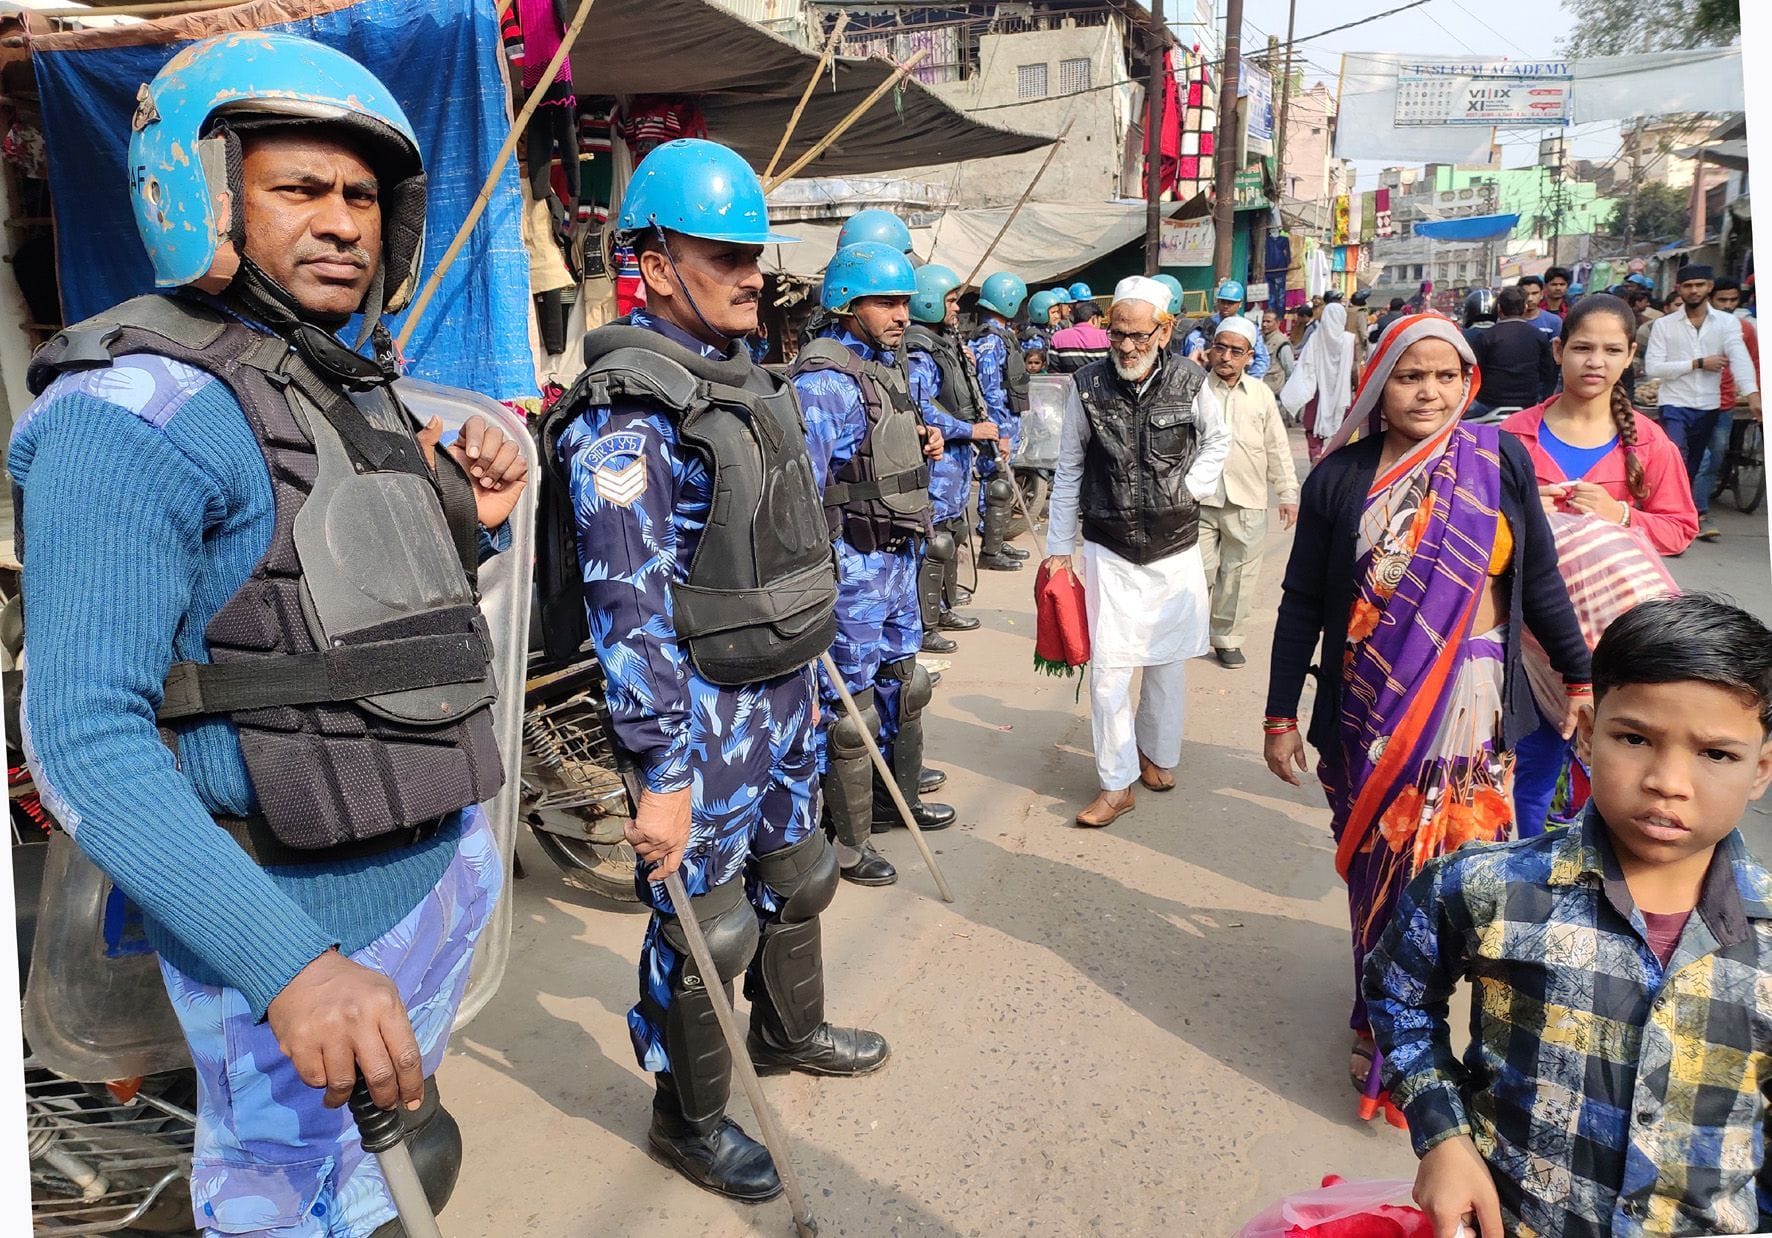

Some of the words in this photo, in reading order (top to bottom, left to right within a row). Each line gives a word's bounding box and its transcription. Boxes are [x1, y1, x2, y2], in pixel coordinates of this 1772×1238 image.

[1491, 63, 1569, 75] ACADEMY
[1467, 100, 1485, 112] XI
[128, 165, 146, 194] AF
